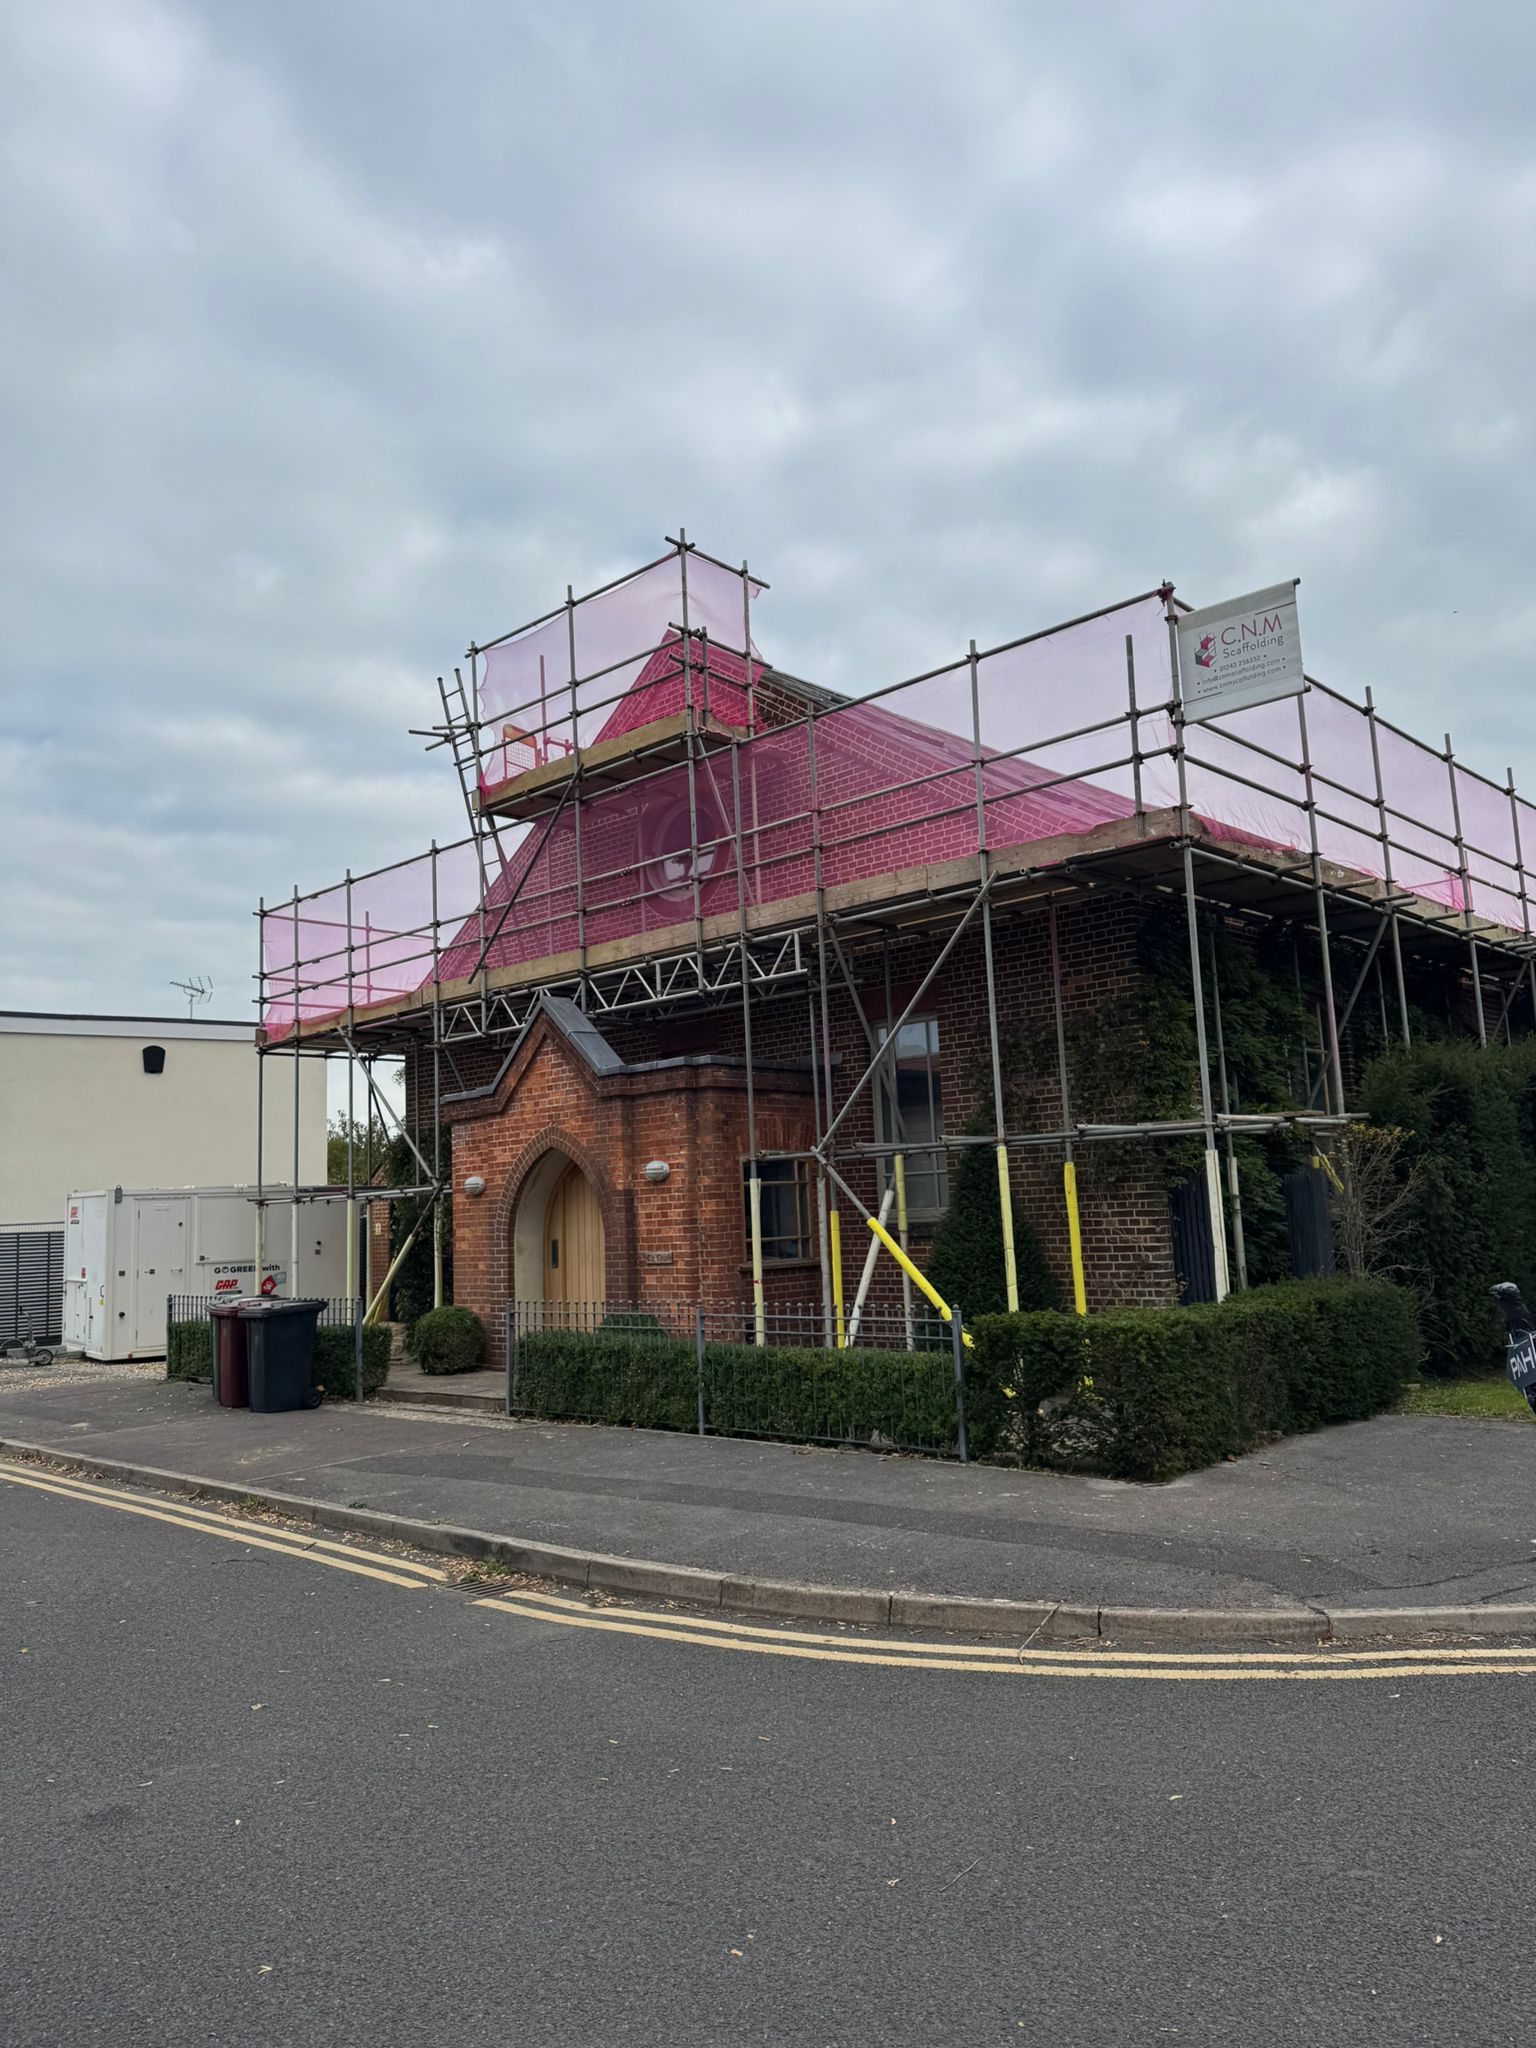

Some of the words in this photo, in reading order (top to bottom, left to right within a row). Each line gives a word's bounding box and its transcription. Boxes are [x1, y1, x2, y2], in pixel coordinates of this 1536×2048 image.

[1222, 613, 1282, 645] C.N.M
[1223, 635, 1284, 658] Scaffolding
[1219, 662, 1237, 672] 01243
[1203, 666, 1282, 694] www.cnmscaffolding.com
